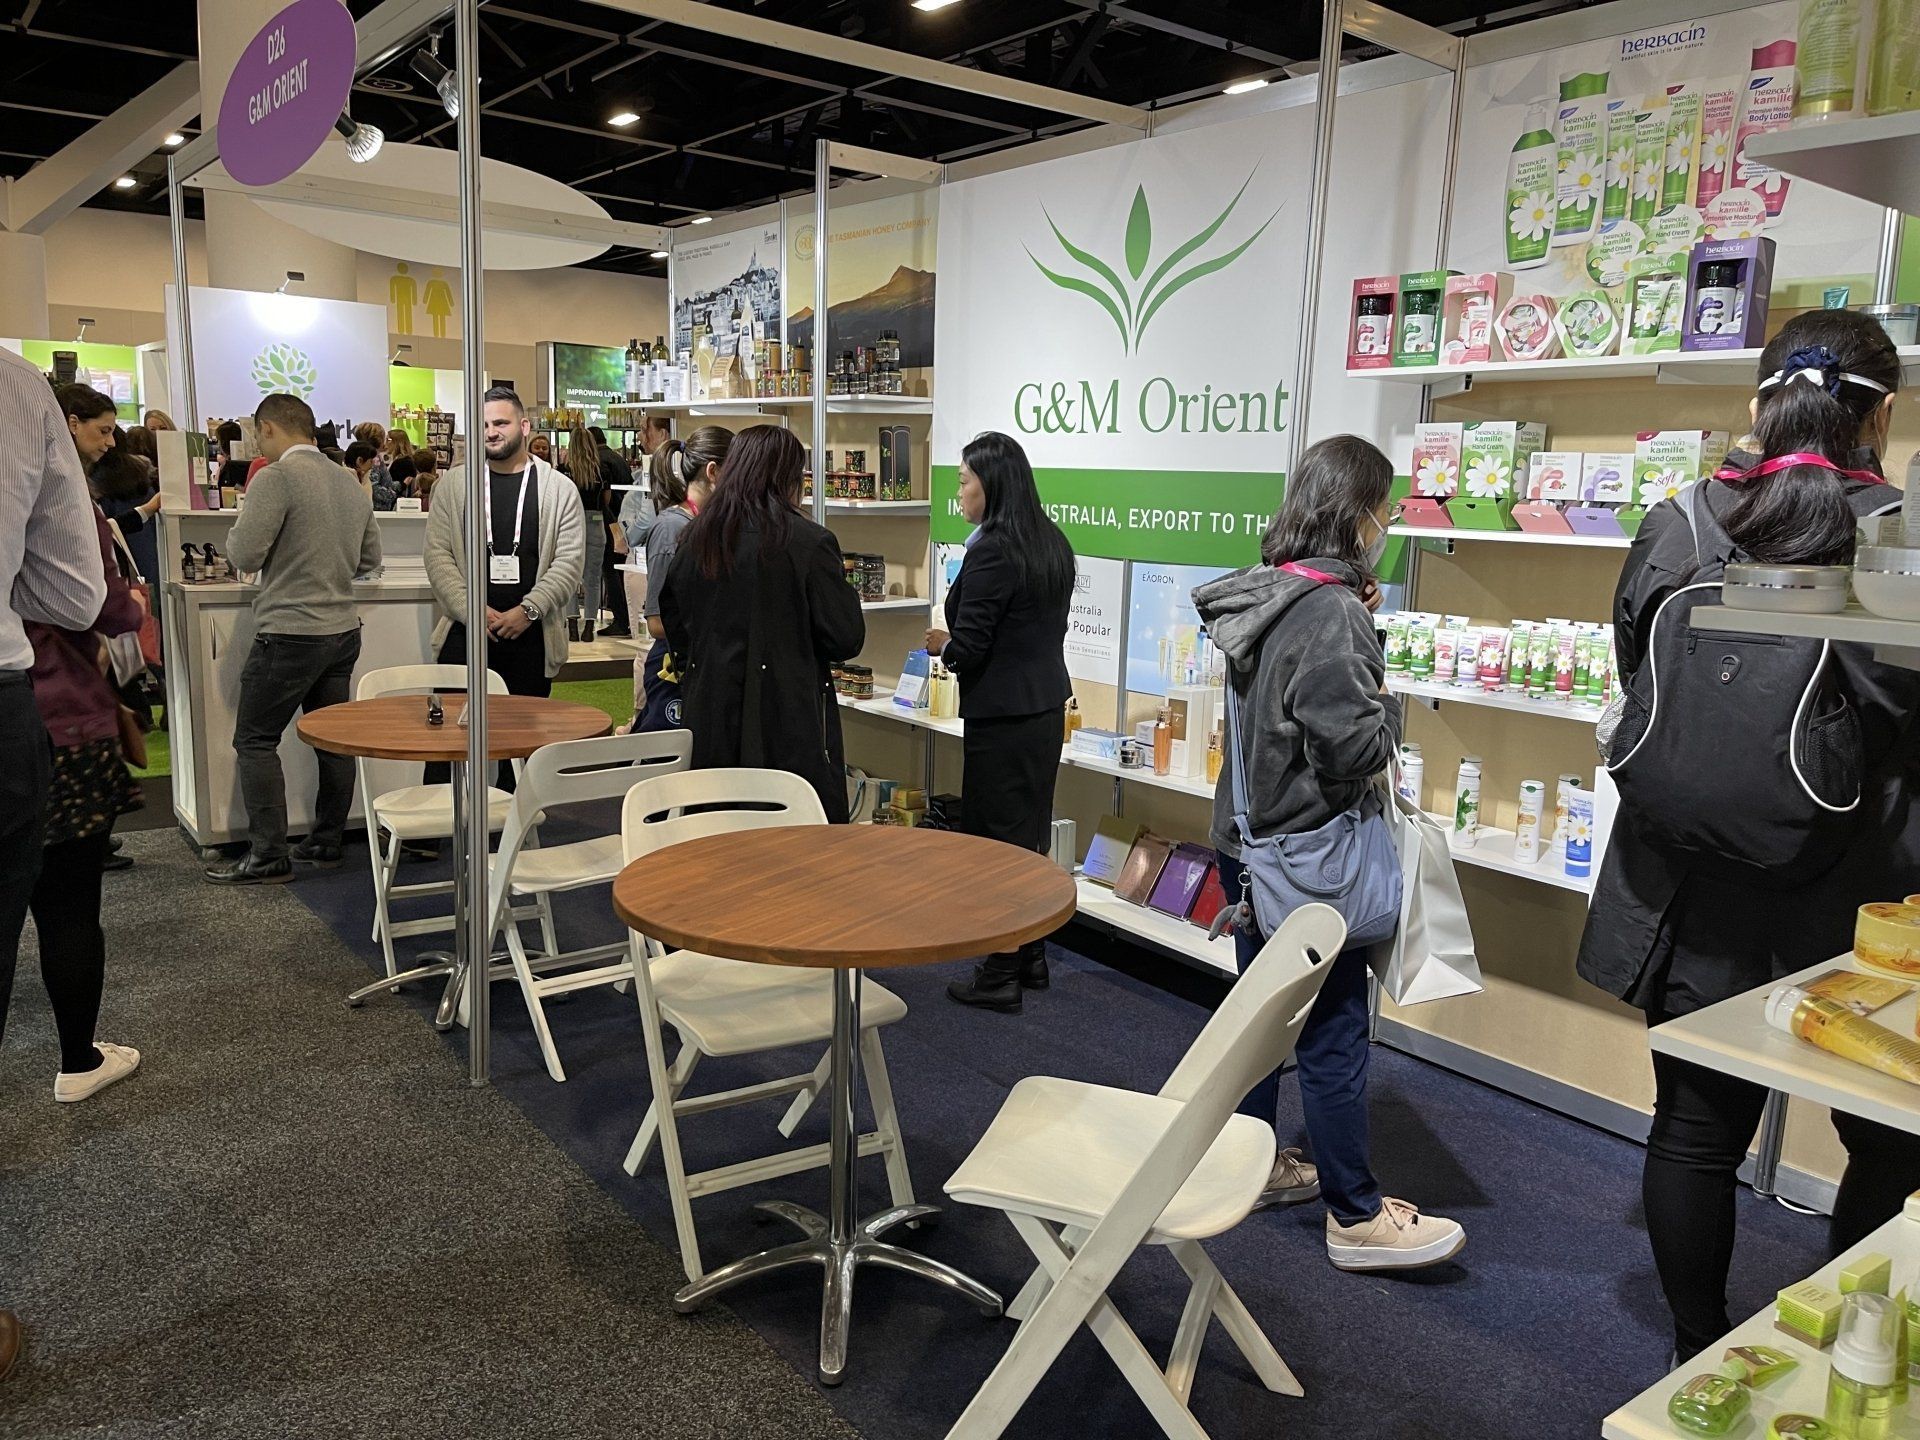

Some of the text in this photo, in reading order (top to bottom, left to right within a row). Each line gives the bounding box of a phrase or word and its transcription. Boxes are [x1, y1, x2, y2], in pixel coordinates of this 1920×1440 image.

[1621, 22, 1706, 54] herbacin
[267, 25, 286, 65] D26
[248, 58, 308, 125] G&M ORIENT
[1670, 99, 1697, 108] amille
[1704, 96, 1734, 106] kamille
[1749, 113, 1769, 122] Body
[1563, 120, 1597, 133] kamille
[1560, 136, 1598, 149] Body Lotion
[1517, 164, 1547, 176] kamille
[1515, 175, 1530, 184] Hand
[1523, 179, 1539, 188] Balm
[1718, 205, 1749, 214] kamille
[835, 228, 871, 241] TASMANIAN
[872, 223, 895, 234] HONEY
[896, 217, 931, 231] COMPANY
[1659, 221, 1689, 230] kamille
[1671, 229, 1691, 237] Cream
[1602, 237, 1631, 246] kamille
[1614, 244, 1633, 252] Cream
[566, 388, 603, 397] IMPROVING
[1014, 377, 1289, 434] G&M Orient
[1650, 446, 1685, 454] kamille
[1655, 469, 1676, 486] soft
[1043, 502, 1270, 536] USTRALIA, EXPORT TO TH
[1070, 604, 1102, 616] ustralia
[1073, 620, 1111, 636] Popular
